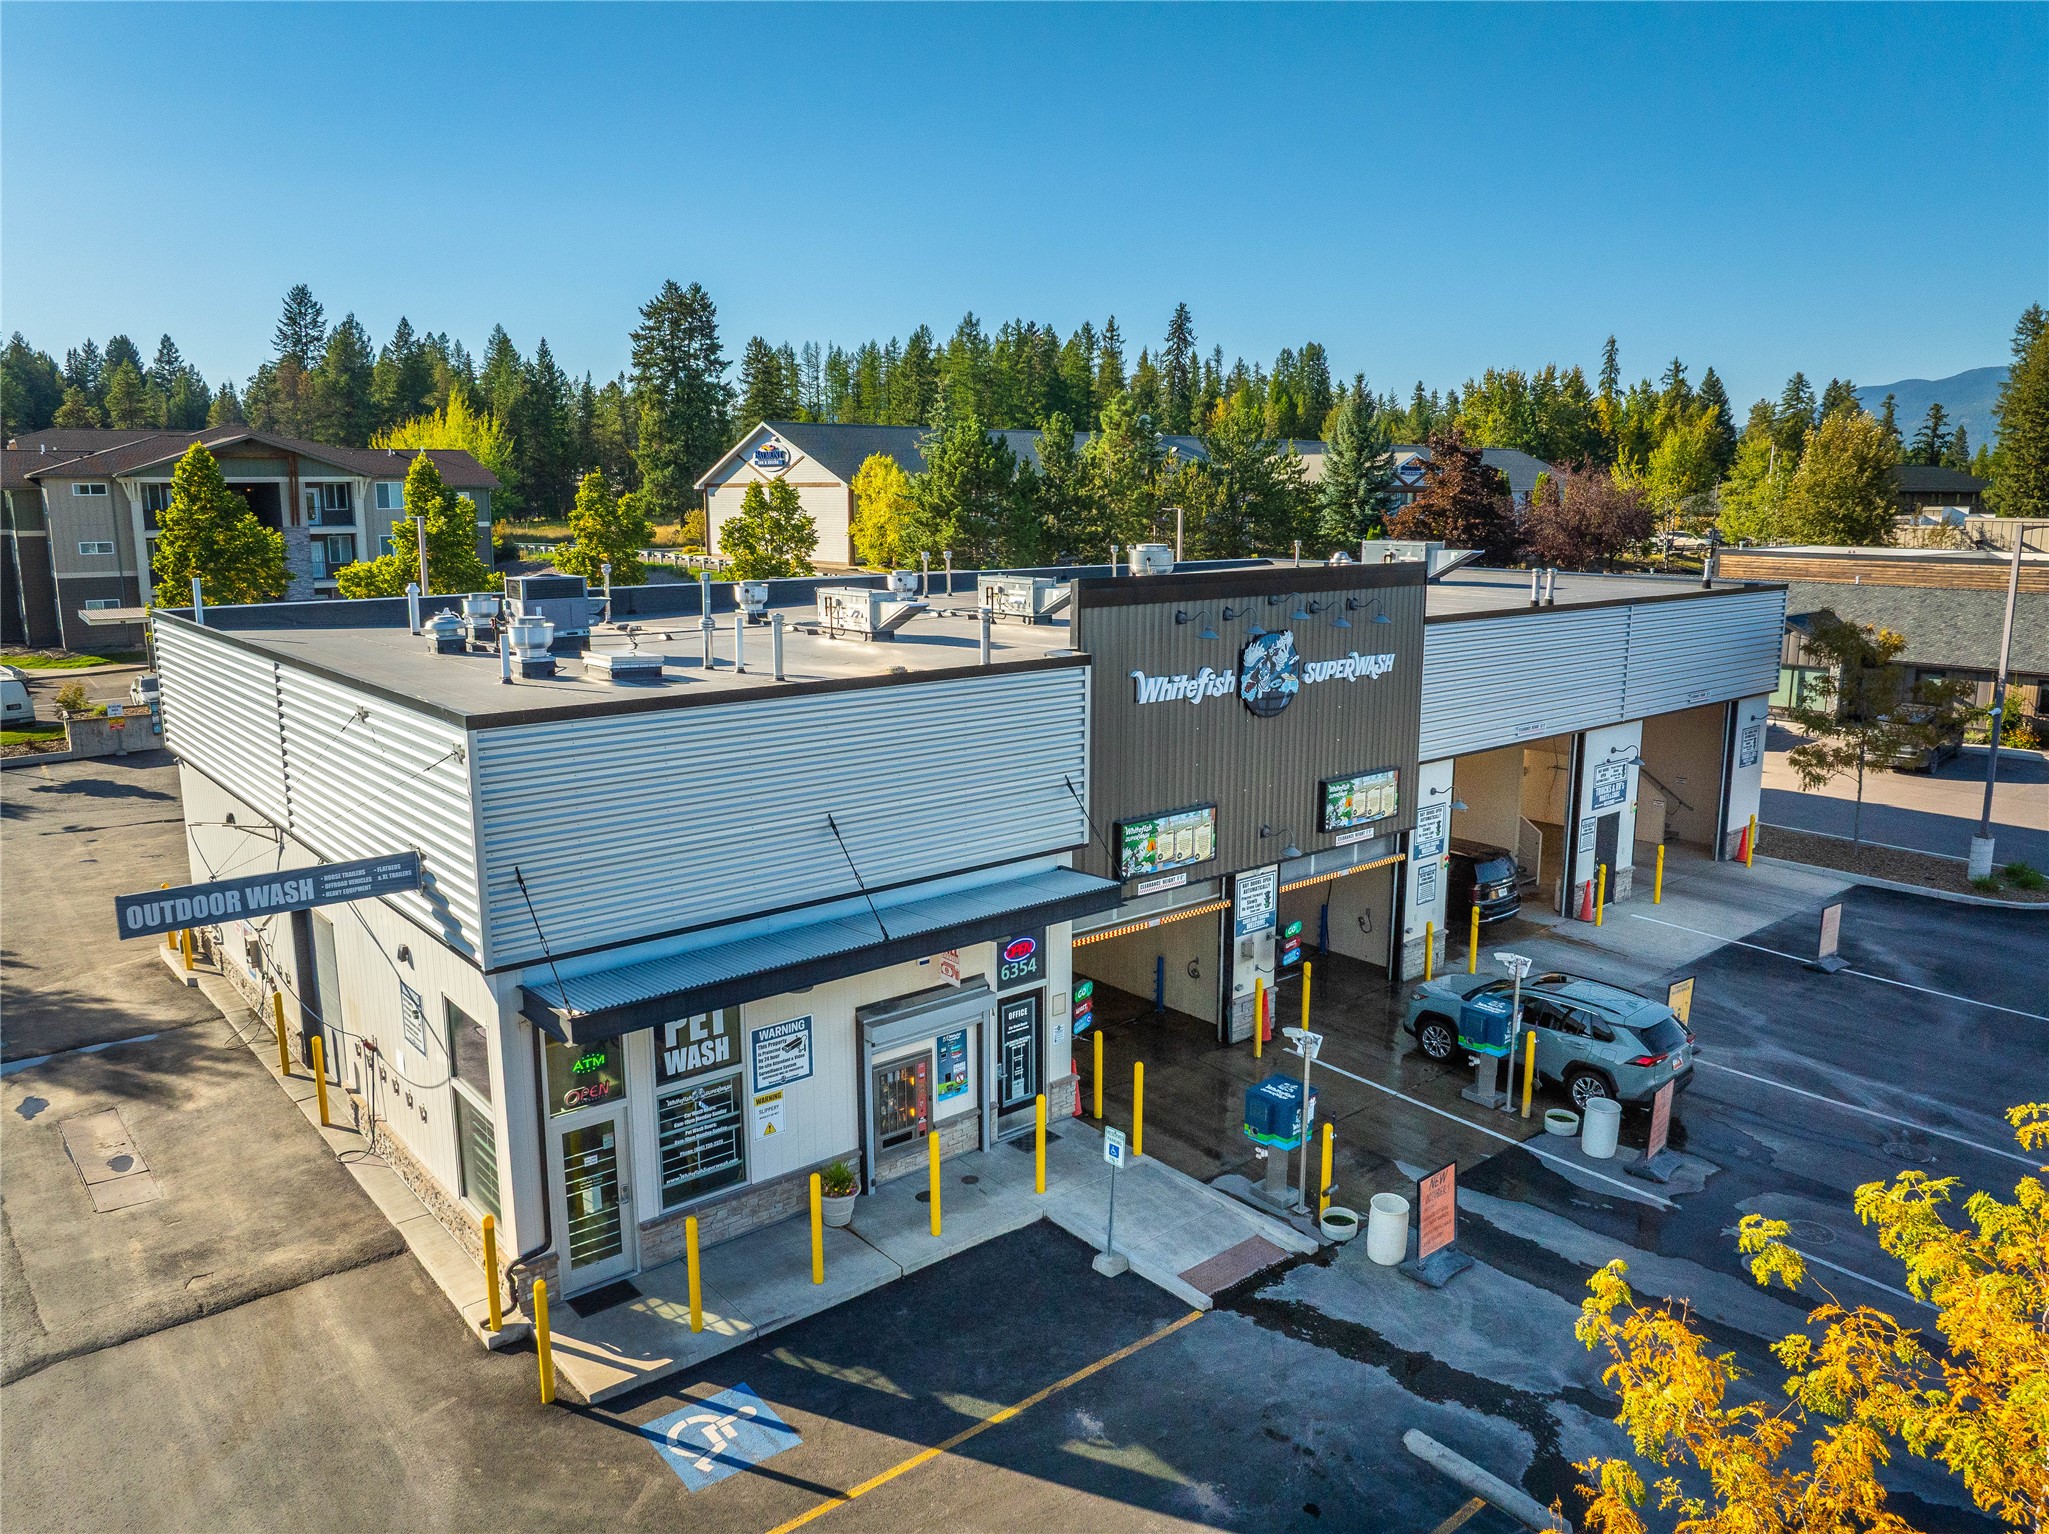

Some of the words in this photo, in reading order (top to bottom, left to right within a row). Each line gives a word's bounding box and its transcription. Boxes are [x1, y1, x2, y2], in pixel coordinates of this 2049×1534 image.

[1130, 666, 1236, 705] Whitefish
[1302, 651, 1396, 684] SUPERWASH
[1596, 783, 1612, 797] TRUCKS
[324, 873, 342, 881] HORSE
[342, 869, 366, 879] TRAILERS
[376, 863, 401, 873] FLATBEDS
[389, 869, 412, 879] TRAILERS
[325, 880, 349, 889] OFFROAD
[348, 876, 373, 886] VEHICLES
[1140, 880, 1160, 890] CLEARANCE
[1162, 876, 1176, 885] HEIGHT
[326, 889, 343, 898] HEAVY
[343, 884, 372, 895] EQUIPMENT
[126, 890, 242, 930] OUTDOOR
[244, 877, 315, 910] WASH
[1288, 925, 1297, 935] GO
[1005, 941, 1033, 959] OPEN
[1001, 957, 1037, 981] 6354
[1077, 987, 1087, 999] GO
[1008, 1007, 1028, 1020] OFFICE
[759, 1019, 805, 1041] WARNING
[767, 1039, 787, 1048] Property
[664, 1036, 730, 1076] WASH
[762, 1047, 781, 1056] Protected
[572, 1054, 606, 1072] ATM
[772, 1057, 791, 1066] Attendant
[758, 1066, 783, 1077] Surveillance
[783, 1062, 797, 1070] System
[564, 1080, 610, 1107] OPEN
[755, 1092, 782, 1106] WARNING
[758, 1104, 779, 1115] SLIPPERY
[1429, 1169, 1449, 1190] NEW
